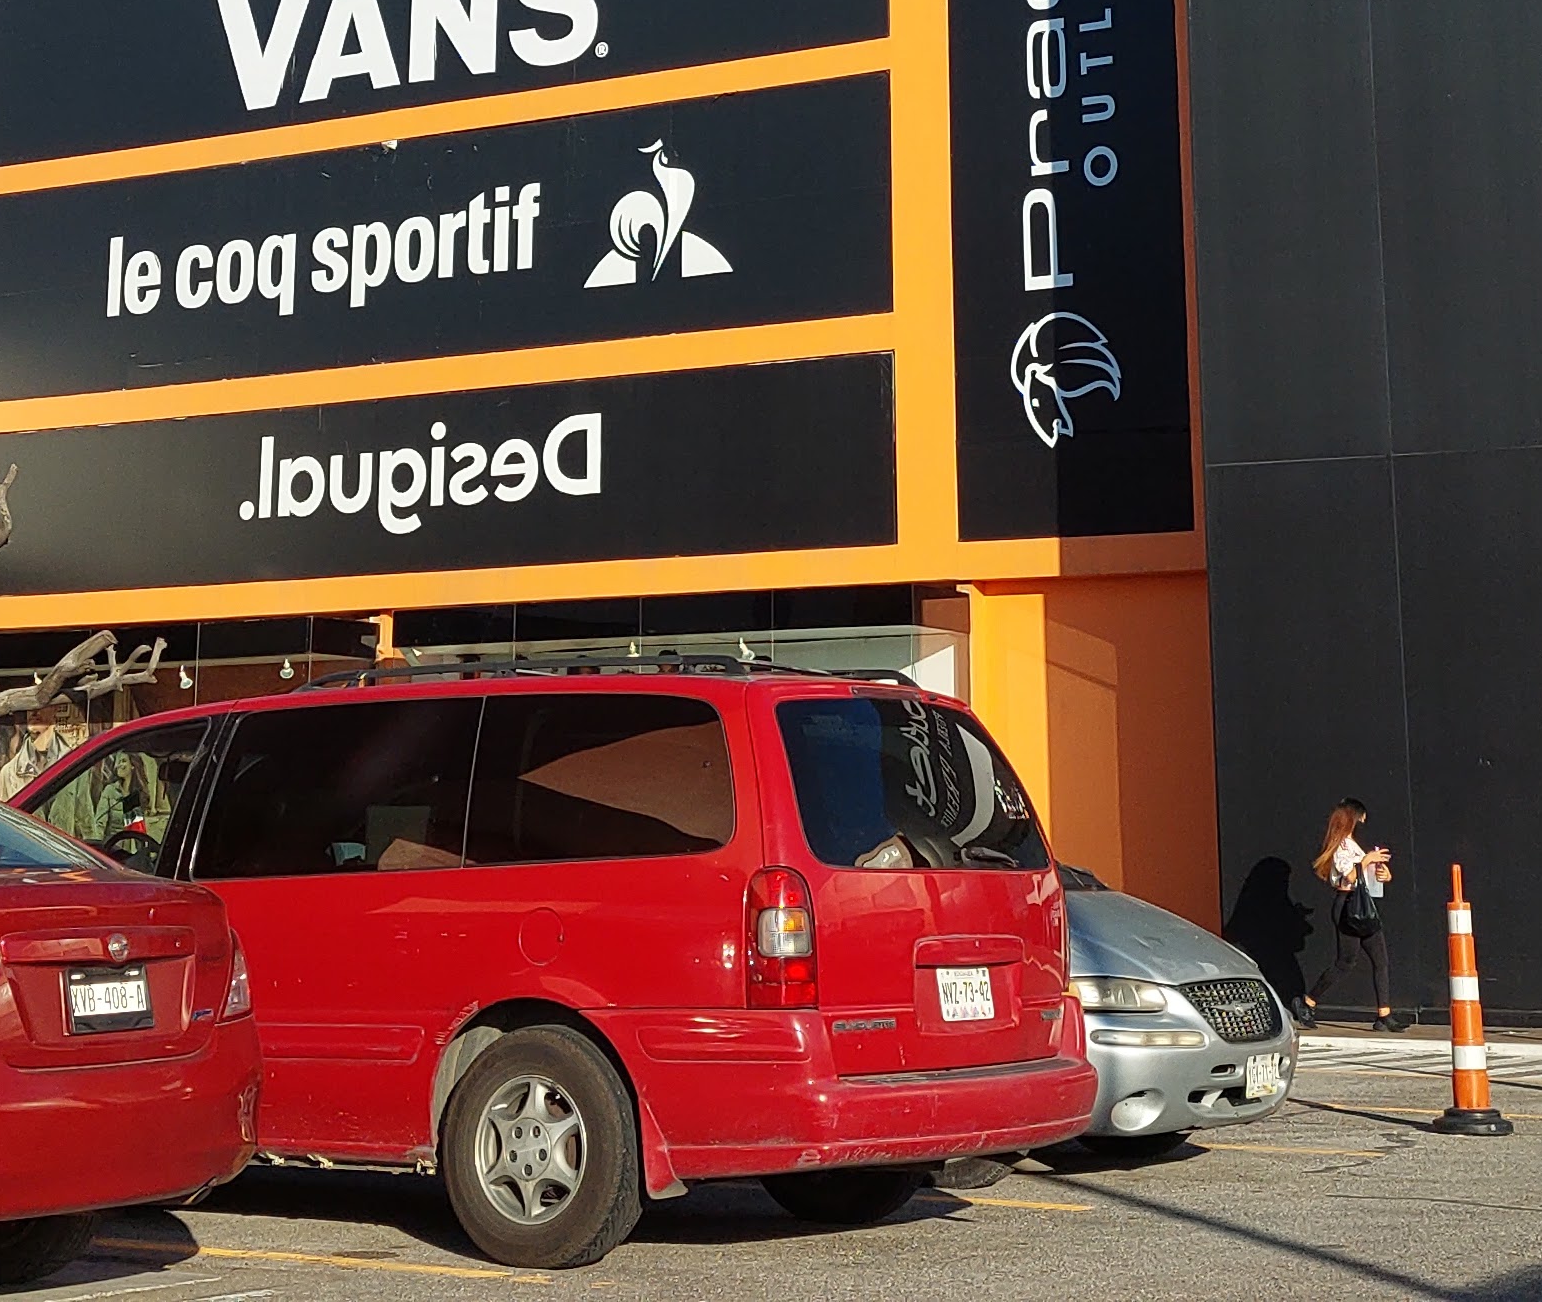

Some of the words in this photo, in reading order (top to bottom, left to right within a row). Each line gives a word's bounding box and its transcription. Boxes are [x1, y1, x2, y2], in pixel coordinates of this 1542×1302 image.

[106, 236, 161, 317] le
[175, 232, 297, 315] coq
[311, 182, 542, 308] sportif
[72, 984, 145, 1012] XVB-408-A
